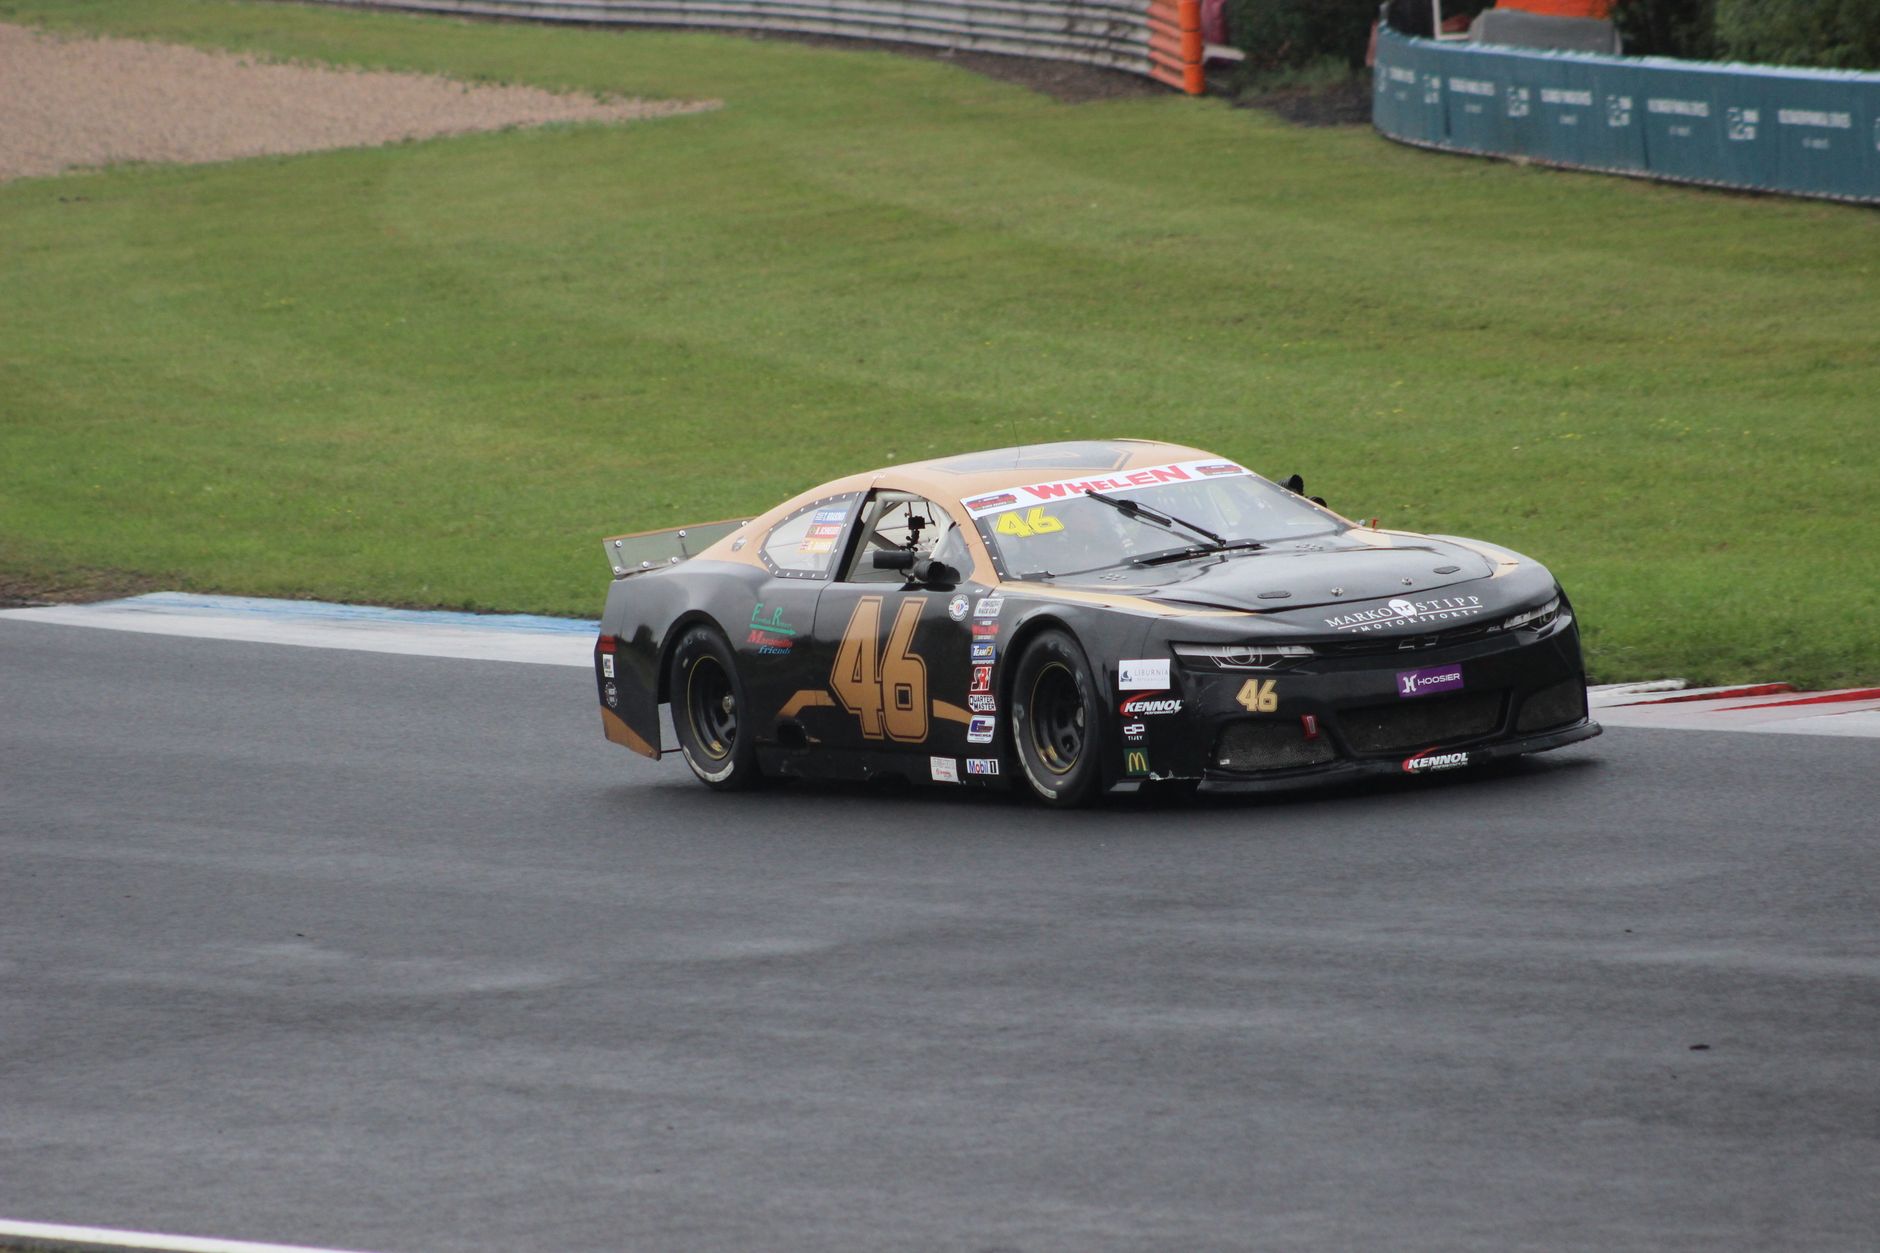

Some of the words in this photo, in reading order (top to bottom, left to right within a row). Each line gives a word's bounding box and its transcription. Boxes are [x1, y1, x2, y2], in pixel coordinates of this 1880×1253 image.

[1021, 465, 1192, 500] WHELEN
[996, 506, 1065, 538] 46
[1324, 607, 1394, 628] MARKO
[1415, 595, 1480, 612] STIPP
[1361, 609, 1470, 632] MOTORSPORT
[829, 595, 929, 744] 46
[1134, 668, 1169, 677] LIBURNIA
[1417, 672, 1461, 686] HOOSIER
[969, 695, 993, 705] QUARTER
[1235, 678, 1278, 713] 46
[1124, 700, 1183, 714] KENNOL
[968, 760, 988, 774] Mobil
[1408, 752, 1469, 769] KENNOL
